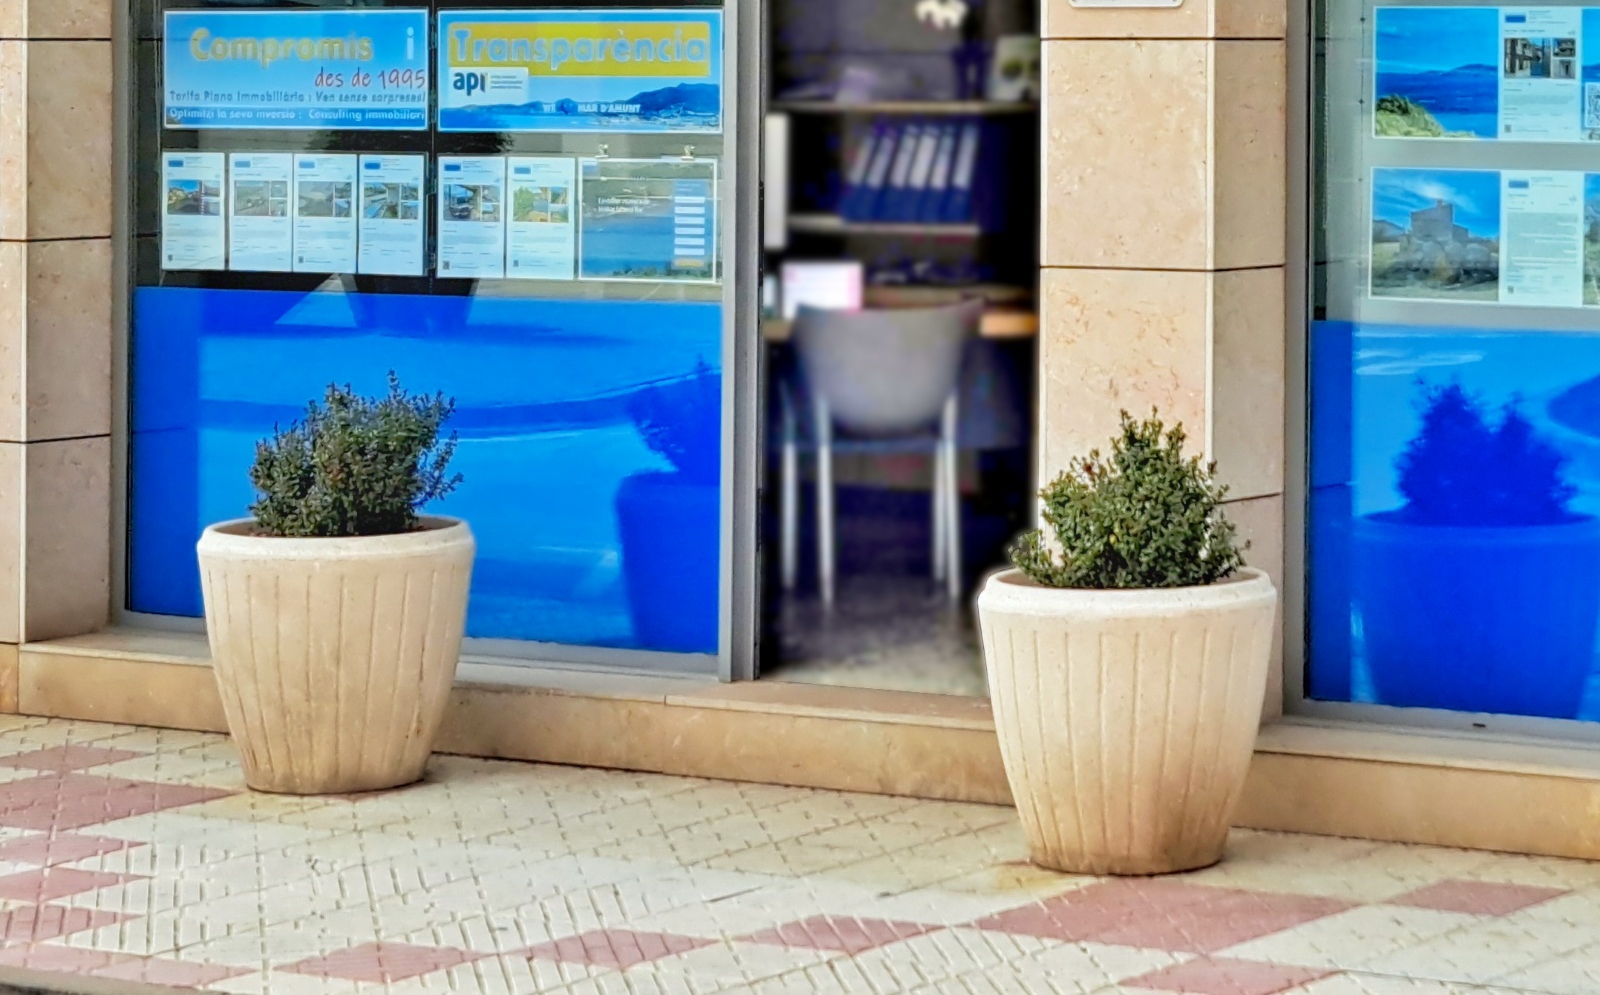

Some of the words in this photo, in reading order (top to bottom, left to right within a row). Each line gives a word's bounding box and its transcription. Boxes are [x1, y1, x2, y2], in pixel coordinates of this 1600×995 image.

[453, 27, 708, 71] Transparència
[314, 67, 344, 88] des
[351, 67, 372, 88] de
[377, 68, 426, 89] 1995
